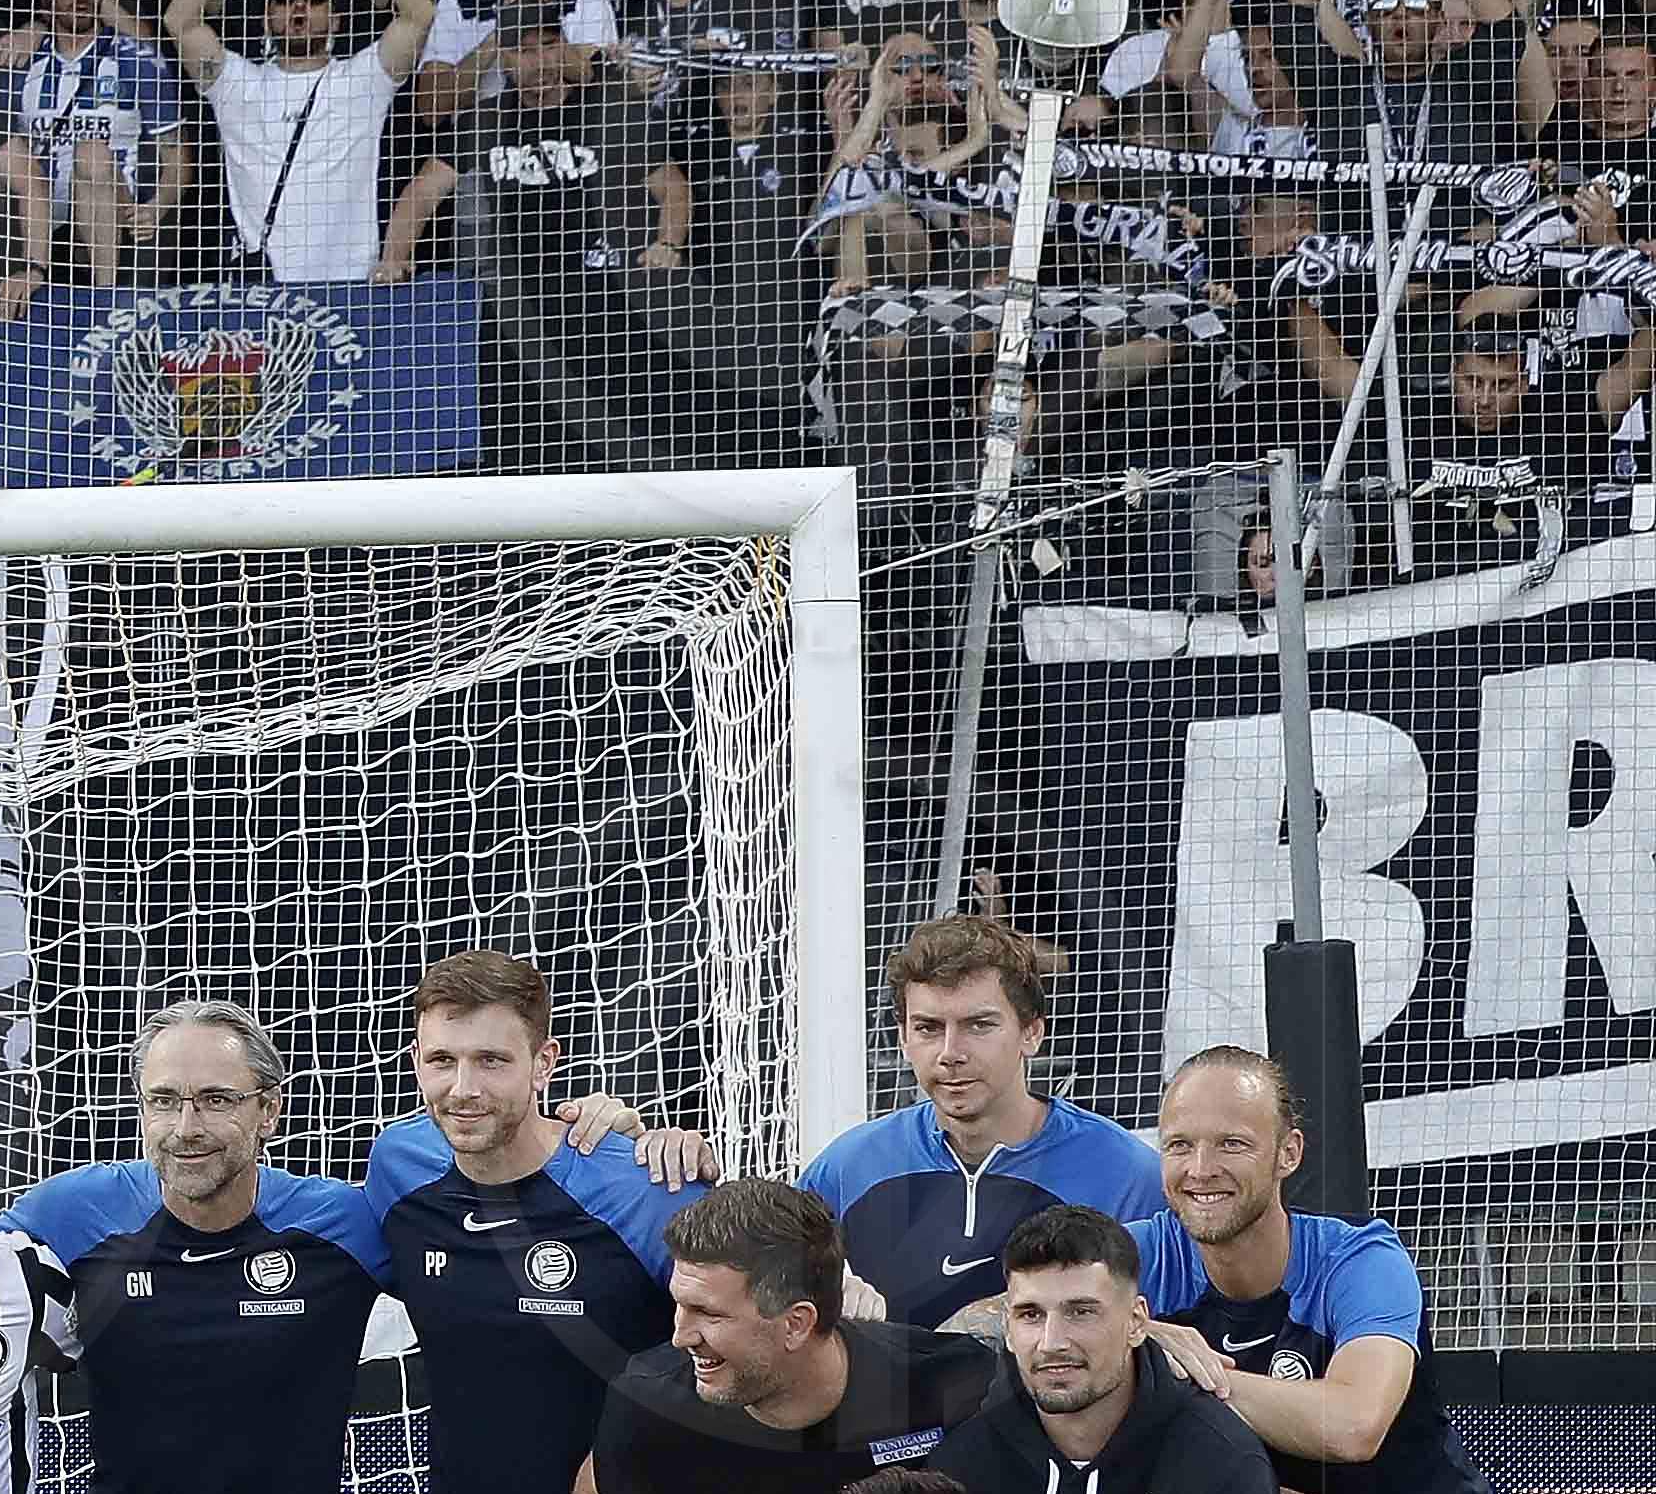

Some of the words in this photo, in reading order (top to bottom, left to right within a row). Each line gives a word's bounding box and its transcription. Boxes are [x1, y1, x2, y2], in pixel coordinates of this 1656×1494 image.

[1089, 142, 1174, 177] UNSER
[1179, 147, 1265, 182] STOLZ
[1273, 153, 1327, 183] DER
[66, 280, 364, 381] EINSATZLEITUNG
[425, 1251, 448, 1277] PP
[126, 1272, 153, 1298] GN
[242, 1301, 302, 1315] PUNTIGAMER
[521, 1300, 583, 1314] PUNTIGAMER
